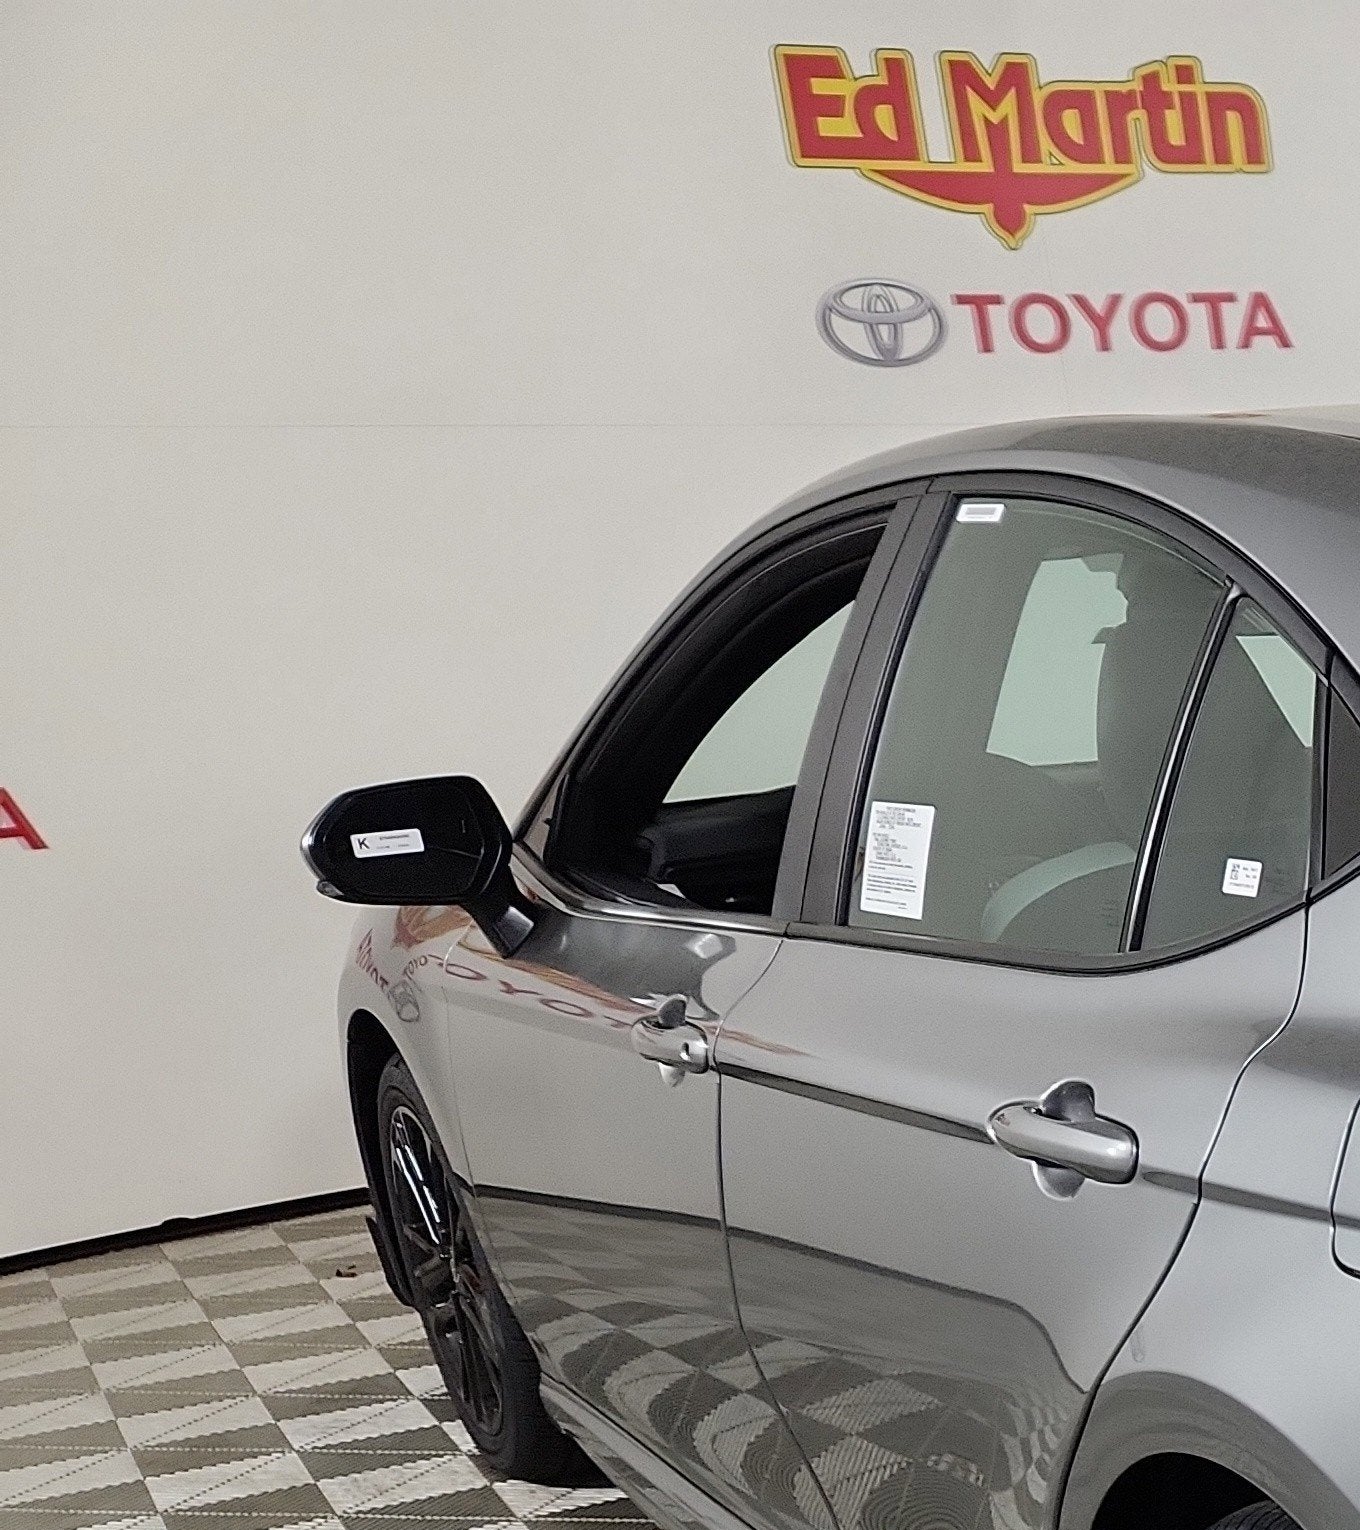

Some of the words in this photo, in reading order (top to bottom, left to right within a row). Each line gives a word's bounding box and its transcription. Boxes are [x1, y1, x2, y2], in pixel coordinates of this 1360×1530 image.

[777, 45, 924, 165] Ed
[943, 51, 1270, 172] Martin
[955, 291, 1294, 354] TOYOTA
